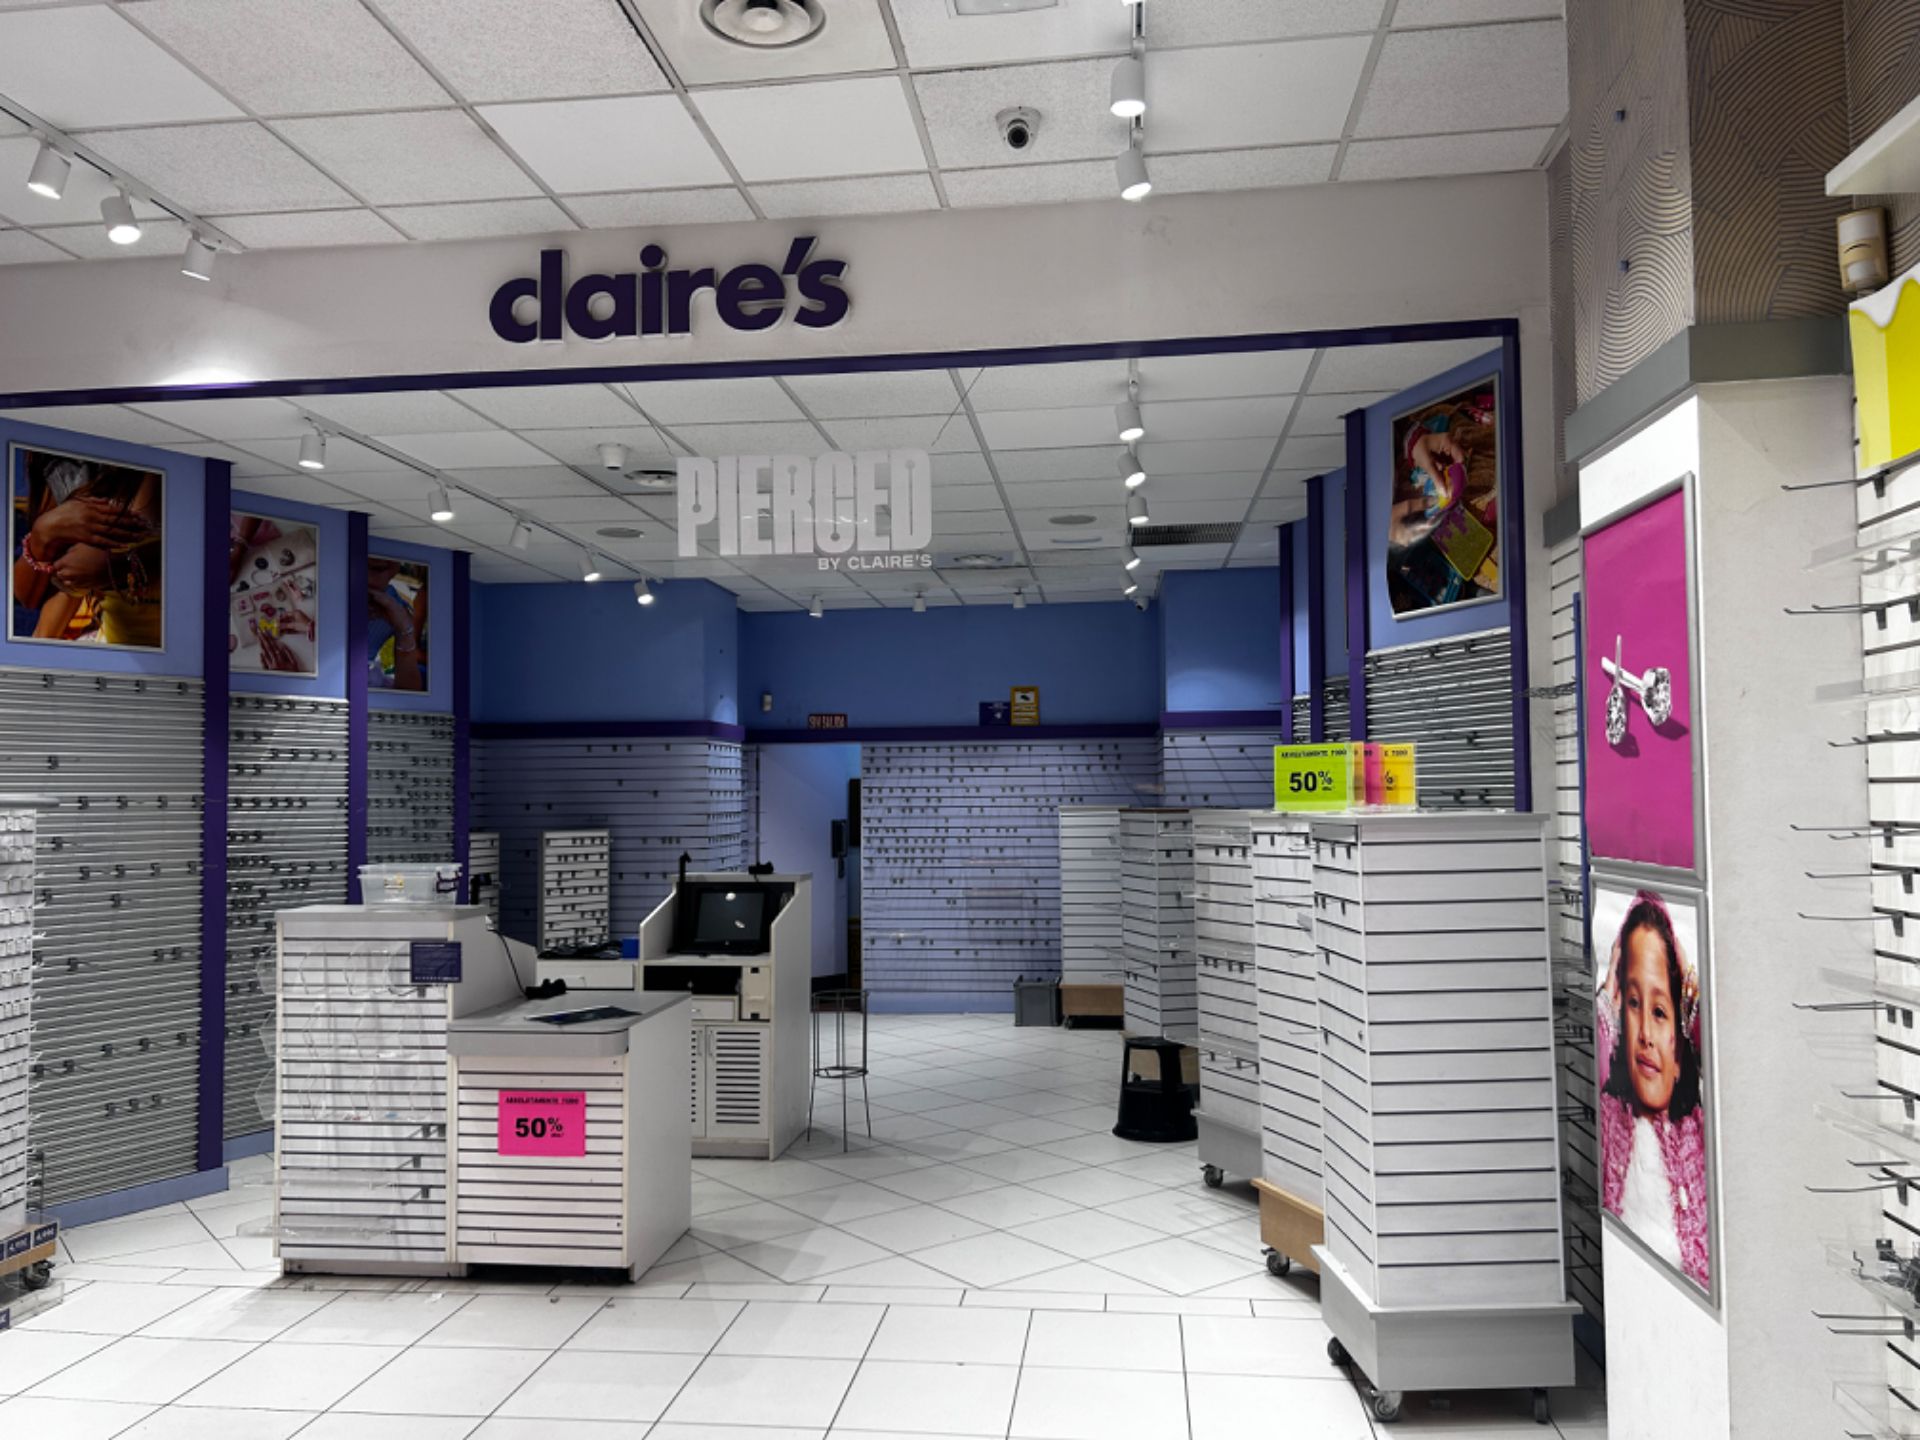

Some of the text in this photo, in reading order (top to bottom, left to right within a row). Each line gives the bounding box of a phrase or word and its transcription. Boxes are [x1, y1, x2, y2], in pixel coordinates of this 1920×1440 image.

[489, 236, 849, 343] claire's
[676, 450, 932, 557] PIERCED
[817, 553, 932, 571] BY CLAIRE'S
[1289, 770, 1333, 792] 50%
[515, 1117, 563, 1138] 50%
